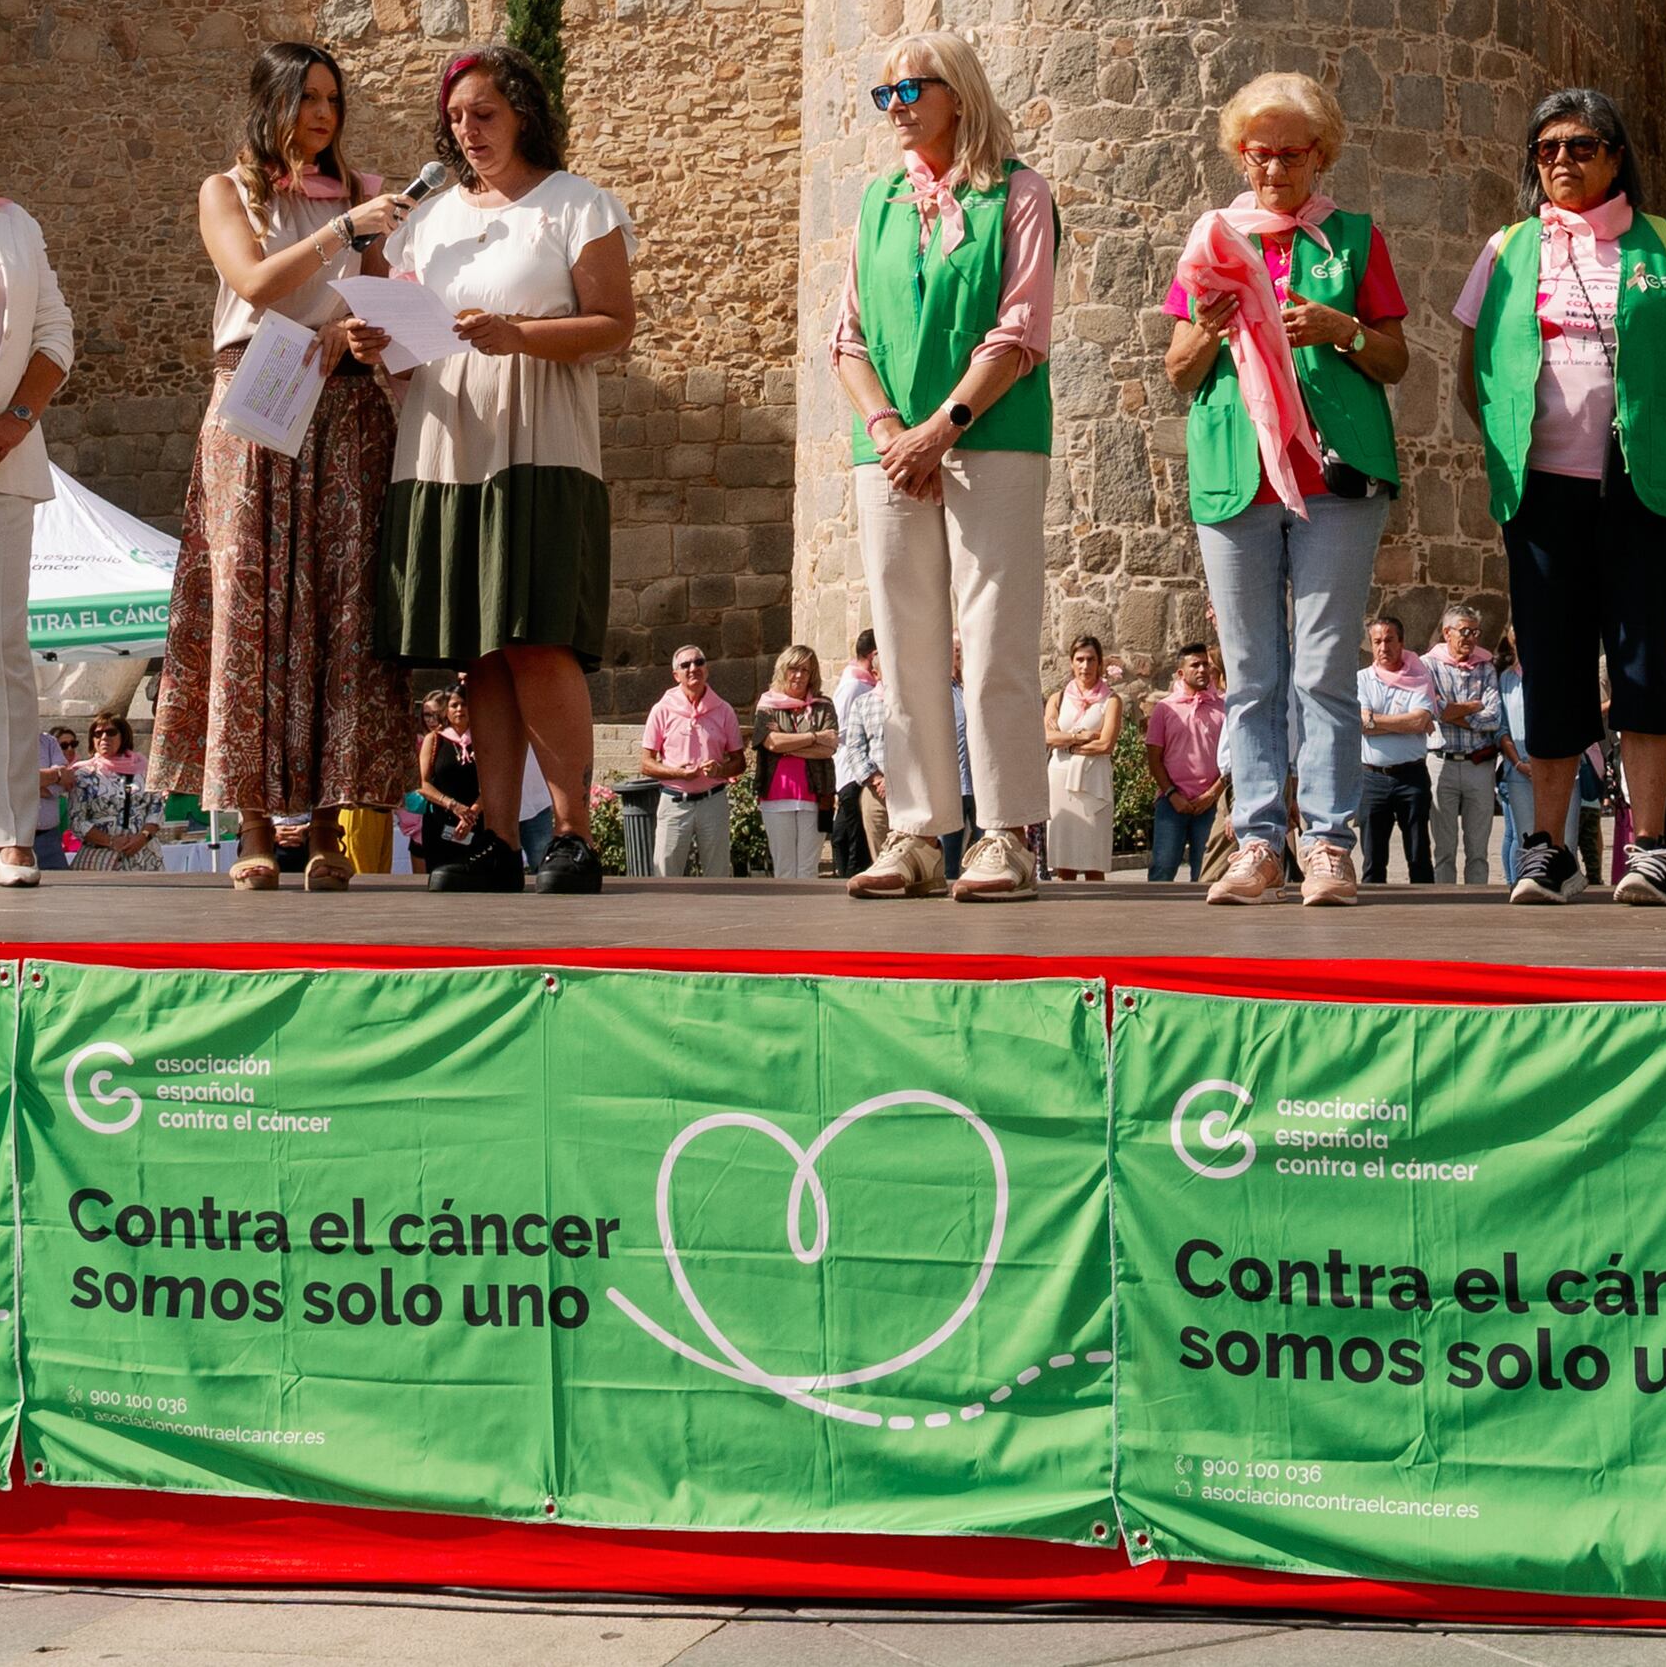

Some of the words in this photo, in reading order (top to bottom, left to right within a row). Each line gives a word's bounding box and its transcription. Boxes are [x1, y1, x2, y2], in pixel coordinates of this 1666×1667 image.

[32, 561, 80, 572] áncer
[80, 610, 106, 630] EL
[155, 1053, 273, 1077] asociación
[156, 1080, 255, 1106] española
[157, 1108, 229, 1131] contra
[232, 1109, 253, 1131] el
[256, 1110, 332, 1133] cáncer
[1276, 1095, 1407, 1121] asociación
[1273, 1123, 1389, 1152] española
[1275, 1155, 1357, 1178] contra
[1362, 1156, 1386, 1179] el
[1390, 1158, 1481, 1182] cáncer
[69, 1188, 291, 1253] Contra
[309, 1198, 374, 1256] el
[389, 1198, 620, 1259] cáncer
[1175, 1239, 1433, 1312] Contra
[1453, 1252, 1530, 1314] el
[72, 1266, 284, 1322] somos
[303, 1267, 442, 1326] solo
[463, 1284, 590, 1329] uno
[1179, 1326, 1425, 1386] somos
[1447, 1328, 1610, 1391] solo
[89, 1389, 121, 1406] 900
[125, 1394, 153, 1410] 100
[156, 1397, 188, 1416] 036
[1202, 1459, 1240, 1478] 900
[1244, 1462, 1281, 1480] 100
[1284, 1464, 1323, 1487] 036
[1200, 1482, 1479, 1520] asociacioncontraelcancer.es
